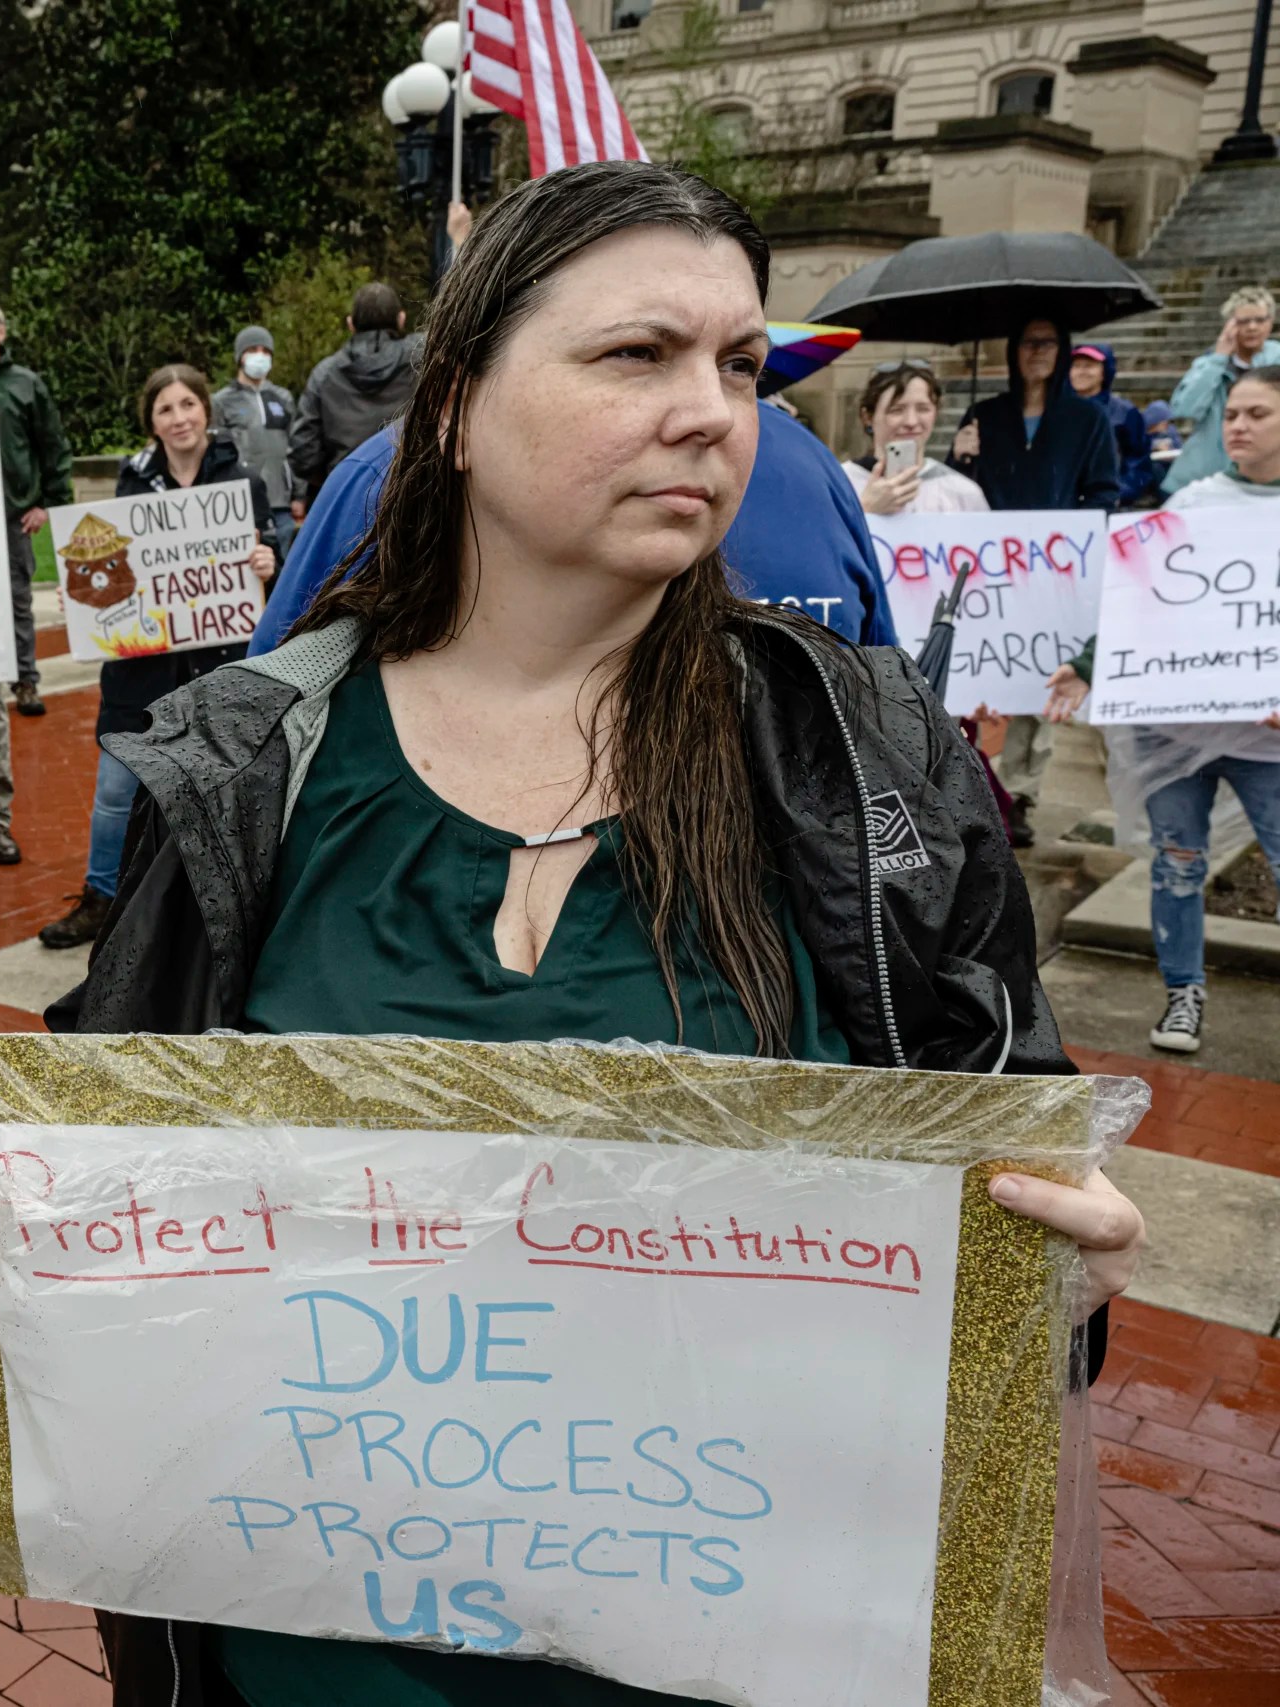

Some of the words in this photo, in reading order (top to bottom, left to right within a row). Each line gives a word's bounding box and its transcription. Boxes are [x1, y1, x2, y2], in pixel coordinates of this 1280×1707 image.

[130, 497, 188, 537] ONLY
[194, 488, 248, 529] YOU
[1110, 511, 1170, 559] FDT
[140, 545, 181, 568] CAN
[183, 533, 253, 560] PREVENT
[152, 560, 253, 606] FASCIST
[168, 601, 257, 646] LIARS
[1106, 647, 1280, 681] Introverts
[876, 851, 926, 874] LLIOT
[347, 1166, 468, 1252] the
[516, 1161, 923, 1282] Constitution
[281, 1289, 556, 1394] DUE
[262, 1405, 774, 1521] PROCESS
[209, 1496, 746, 1597] PROTECTS
[363, 1571, 524, 1652] US
